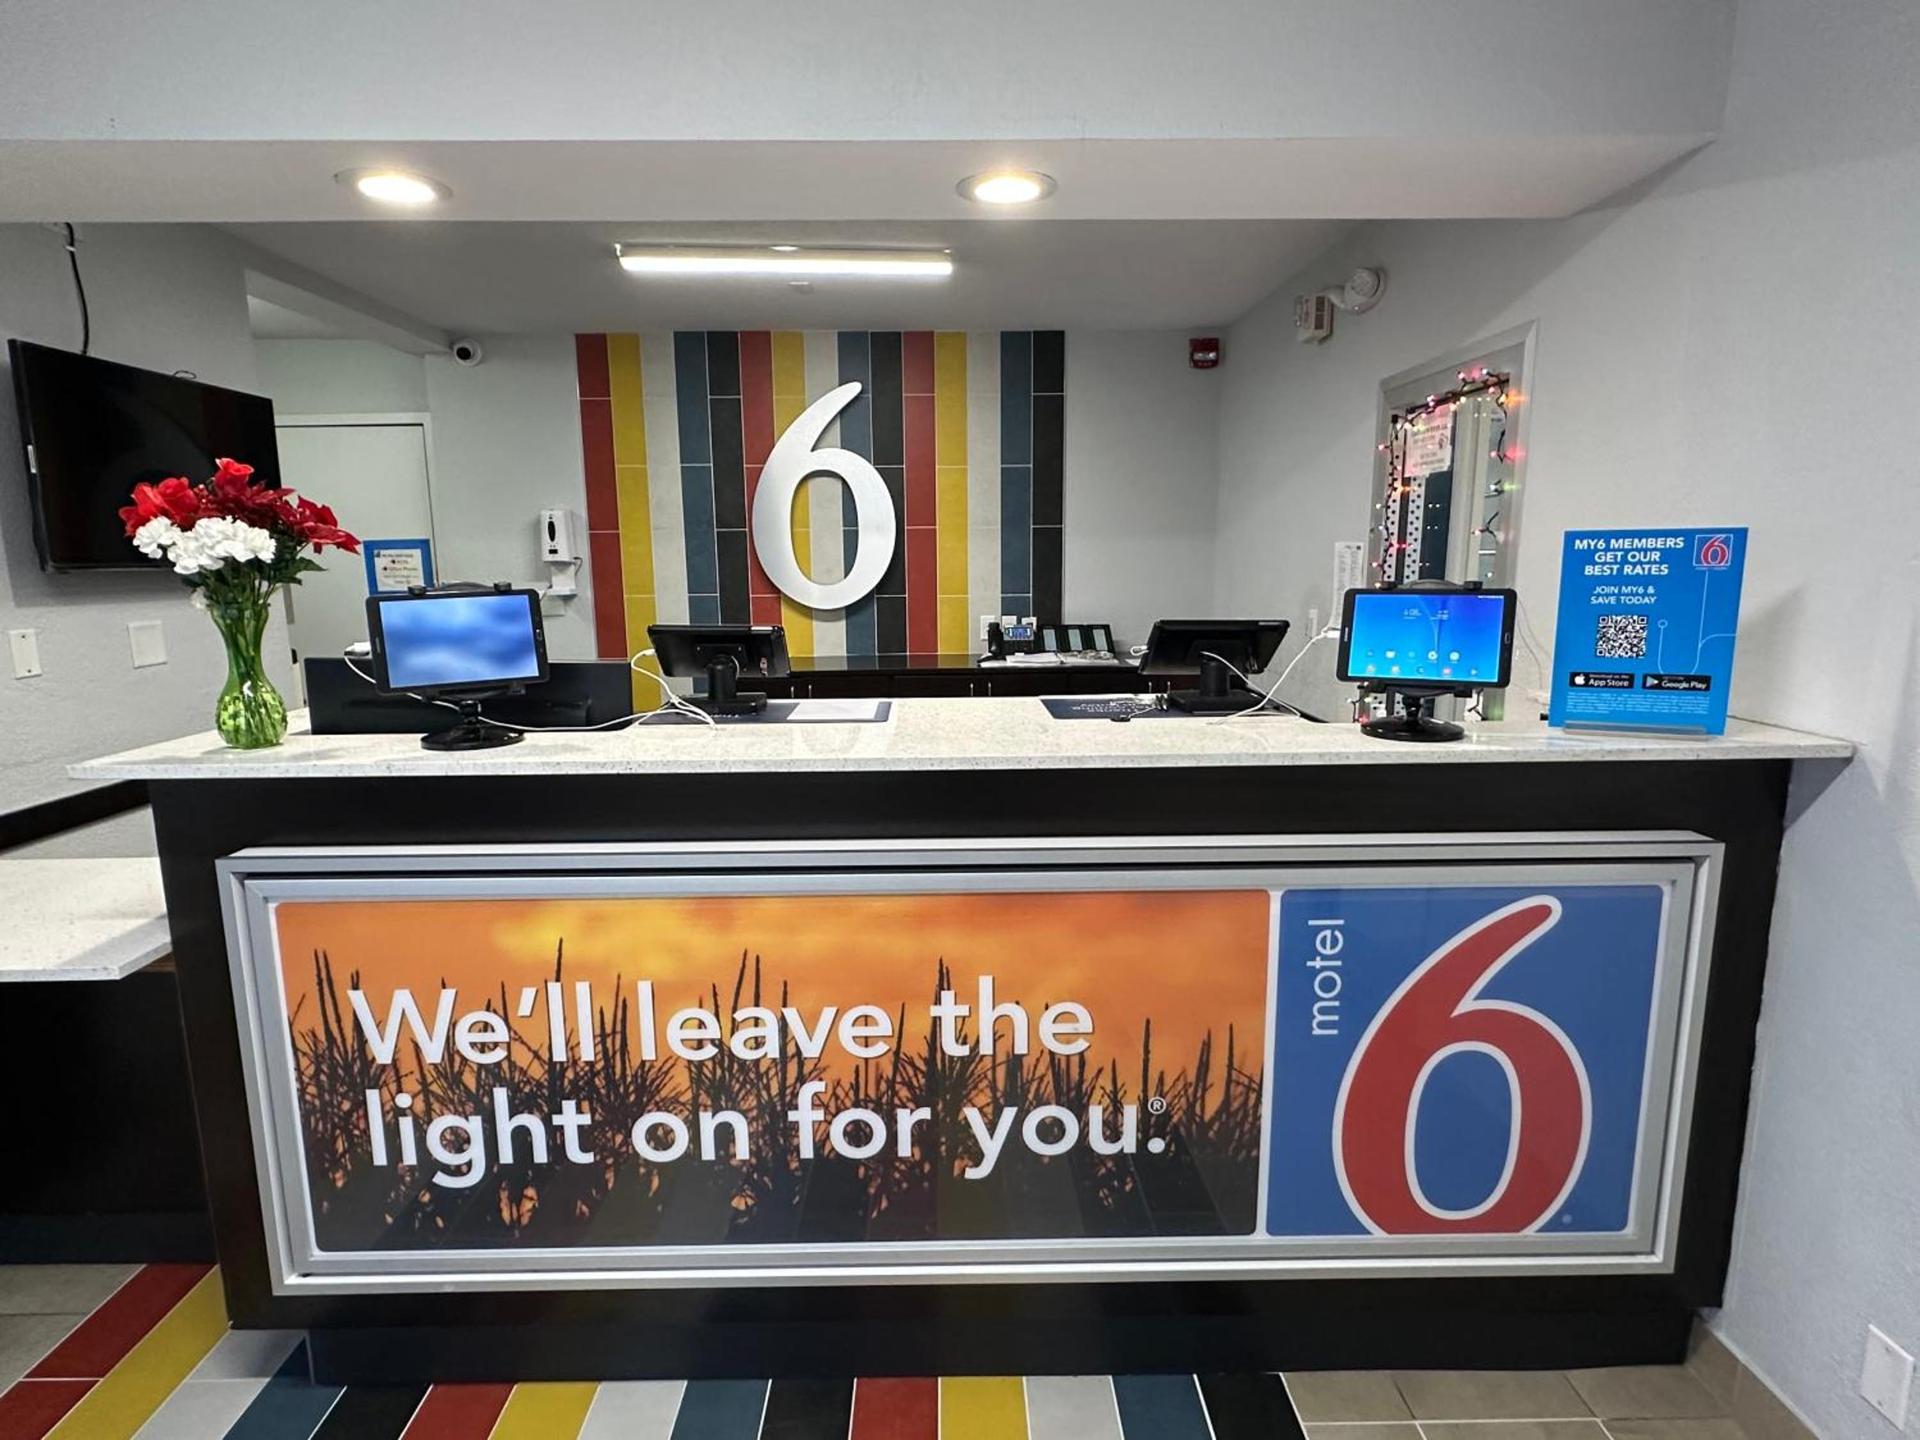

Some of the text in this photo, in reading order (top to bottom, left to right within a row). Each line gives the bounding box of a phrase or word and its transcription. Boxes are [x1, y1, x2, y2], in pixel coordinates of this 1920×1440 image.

[752, 381, 897, 610] 6
[1574, 537, 1685, 550] MY6 MEMBERS
[1700, 534, 1729, 566] 6
[1594, 551, 1660, 562] GET OUR
[1584, 564, 1669, 576] BEST RATES
[1593, 586, 1655, 594] JOIN MY6 &
[1590, 596, 1657, 605] SAVE TODAY
[1588, 679, 1630, 687] App Store
[1661, 680, 1708, 690] Google Play
[1306, 918, 1345, 1037] motel
[348, 975, 1093, 1064] We'll leave the
[1332, 894, 1593, 1236] 6
[365, 1086, 594, 1188] light
[631, 1108, 750, 1163] on
[786, 1080, 931, 1161] for
